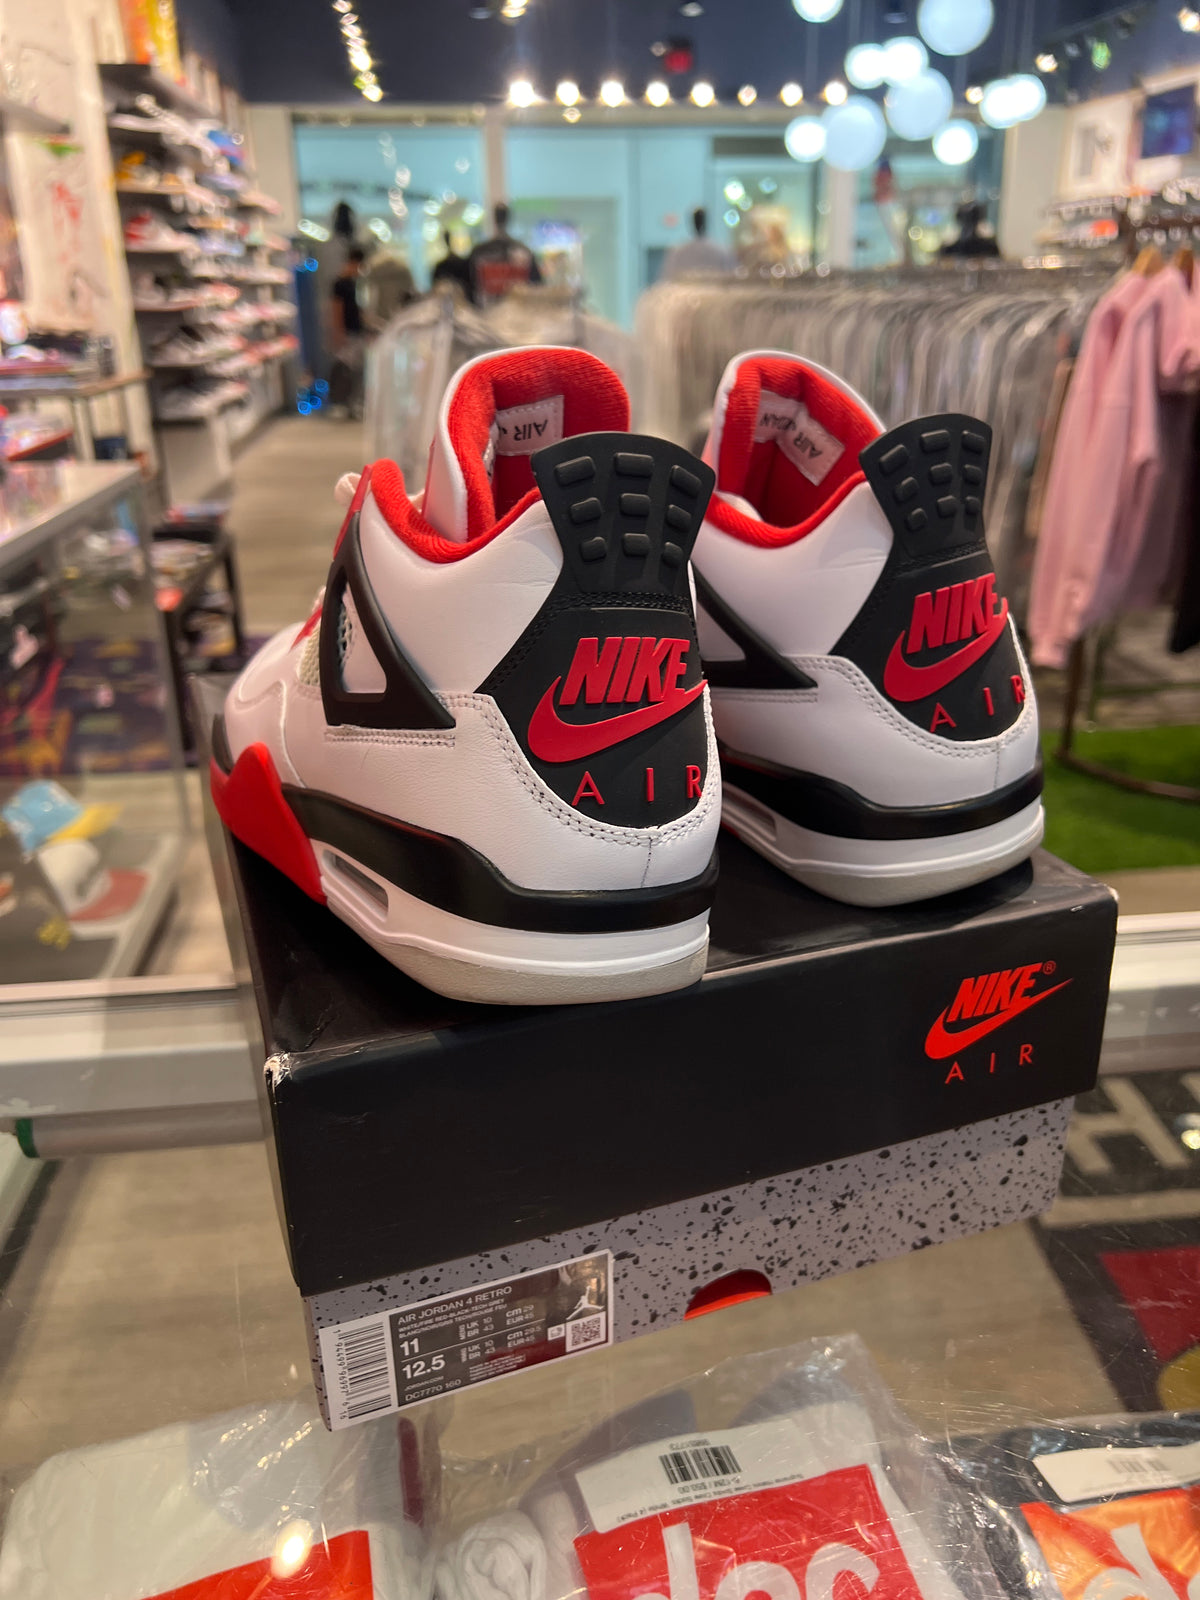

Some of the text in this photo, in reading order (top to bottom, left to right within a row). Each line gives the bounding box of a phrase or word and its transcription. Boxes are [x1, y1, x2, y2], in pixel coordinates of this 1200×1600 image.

[513, 419, 548, 441] AIR
[793, 431, 823, 459] AIR
[905, 571, 999, 655] NIKE
[558, 636, 691, 706] NIKE
[929, 674, 1026, 734] AIR
[571, 764, 703, 806] AIR
[945, 961, 1043, 1023] NIKE
[944, 1043, 1034, 1085] AIR
[397, 1285, 513, 1325] AIR JORDAN 4 RETRO
[466, 1304, 535, 1329] UK 10 cm 29
[466, 1329, 480, 1337] BR
[483, 1324, 494, 1332] 43
[505, 1315, 524, 1326] EUR
[399, 1337, 420, 1357] 11
[467, 1343, 481, 1352] UK
[484, 1339, 494, 1348] 10
[506, 1330, 524, 1341] cm
[468, 1351, 482, 1360] BR
[507, 1339, 525, 1348] EUR
[401, 1354, 446, 1380] 12.5
[404, 1378, 462, 1401] DC7770 160
